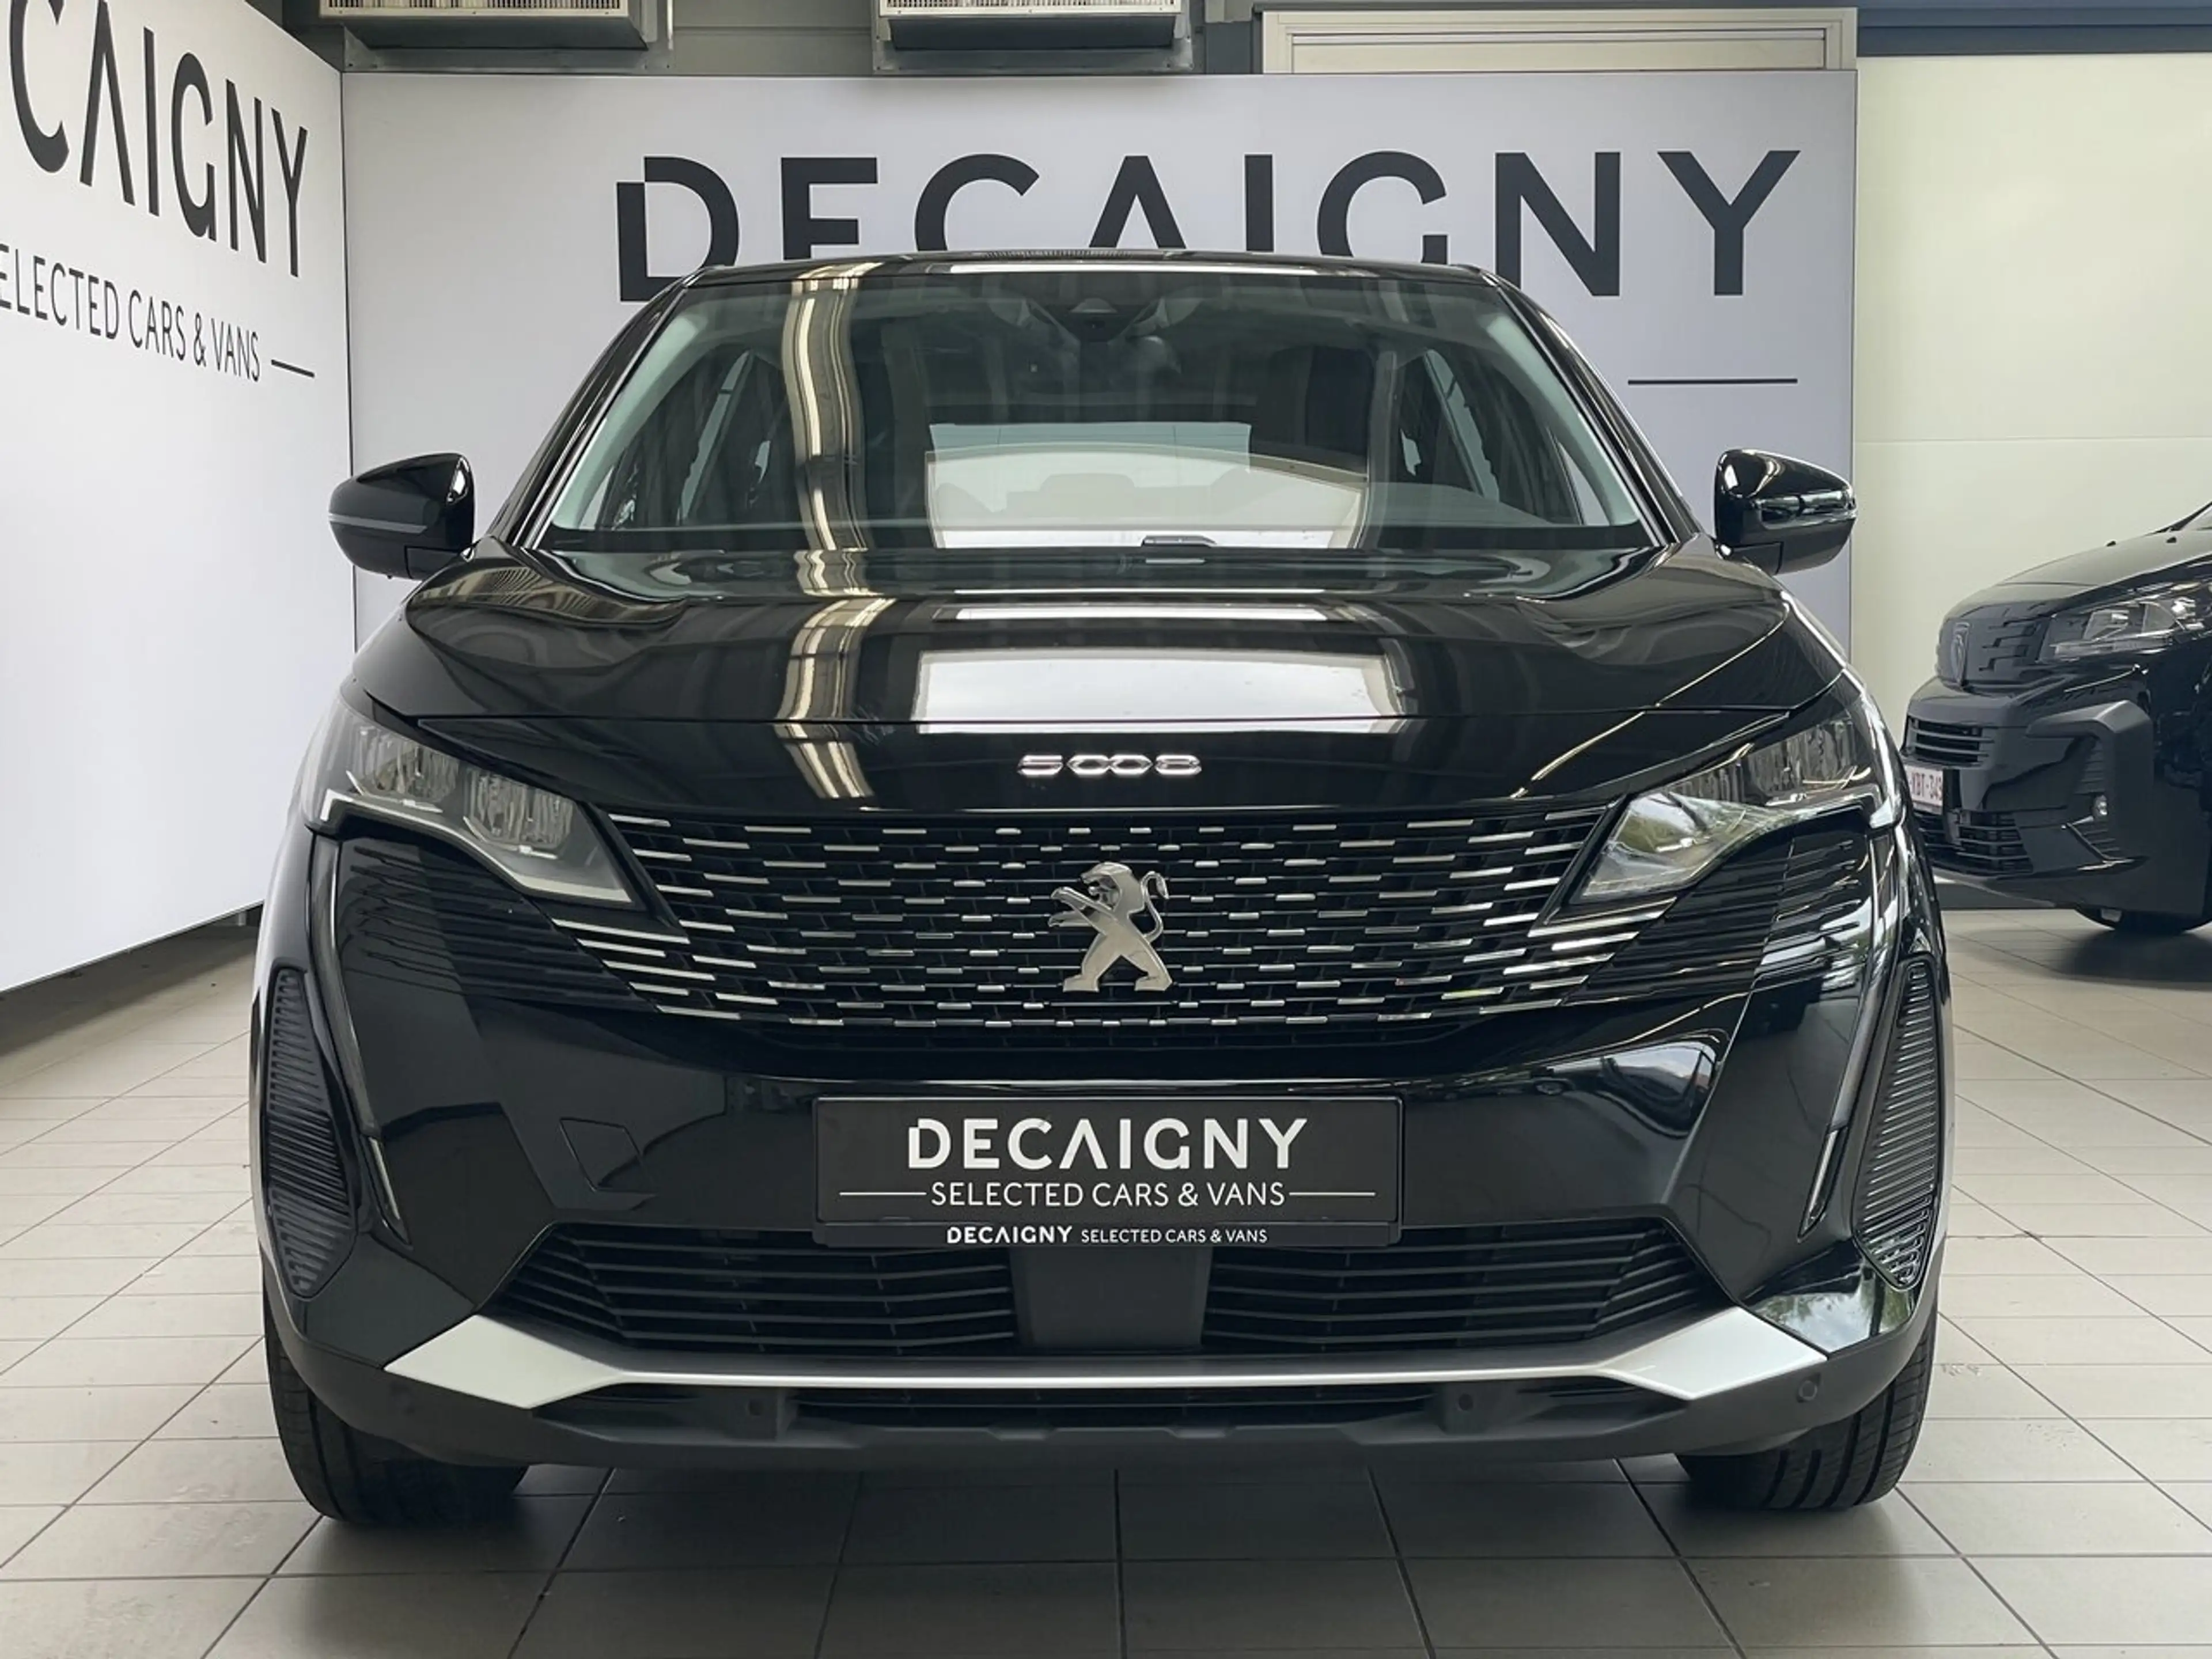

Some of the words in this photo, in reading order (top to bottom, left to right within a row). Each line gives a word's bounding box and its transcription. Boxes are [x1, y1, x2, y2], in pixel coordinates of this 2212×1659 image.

[10, 0, 308, 278] CAIGNY
[616, 150, 1801, 302] DECAIGNY
[128, 290, 186, 361] CARS
[193, 312, 206, 367] &
[211, 317, 260, 382] VANS
[1018, 755, 1202, 776] 5008
[908, 1118, 1308, 1170] DECAIGNY
[931, 1181, 1084, 1207] SELECTED
[1092, 1181, 1169, 1207] CARS
[1177, 1182, 1199, 1207] &
[1206, 1181, 1285, 1206] VANS
[946, 1225, 1073, 1244] DECAIGNY
[1081, 1229, 1162, 1243] SELECTED
[1165, 1229, 1206, 1243] CARS
[1210, 1229, 1222, 1243] &
[1225, 1229, 1268, 1243] VANS
